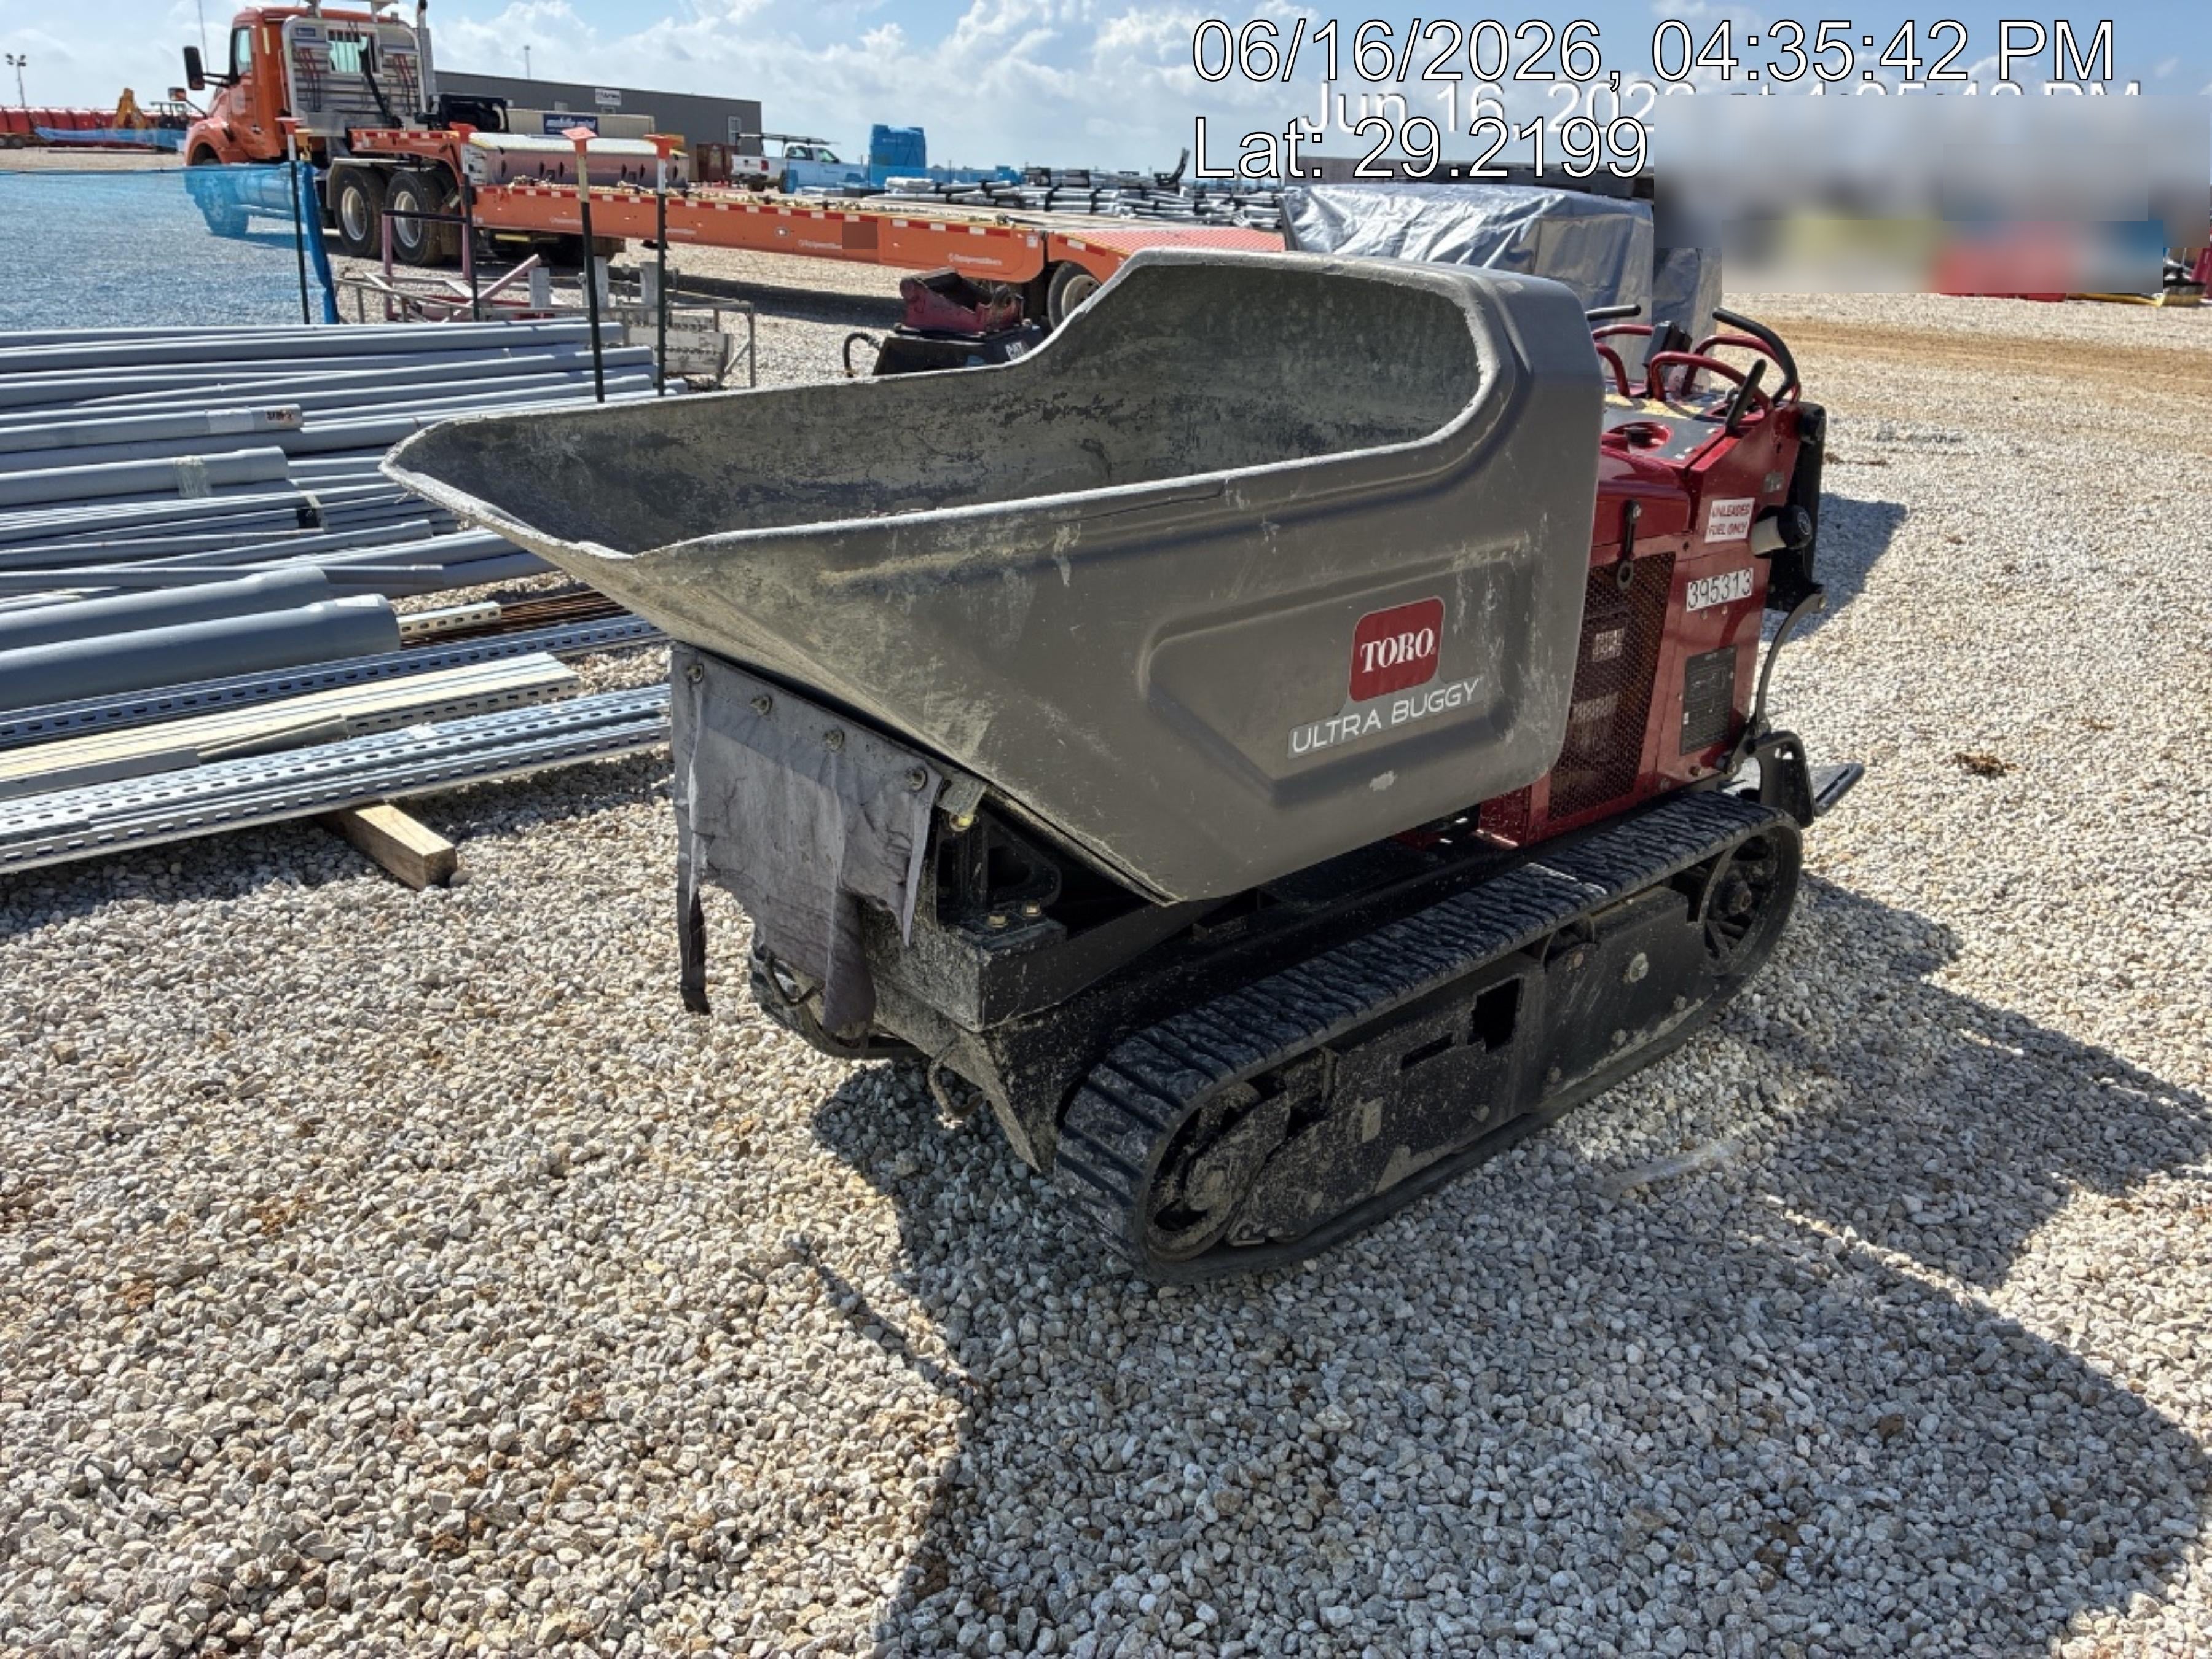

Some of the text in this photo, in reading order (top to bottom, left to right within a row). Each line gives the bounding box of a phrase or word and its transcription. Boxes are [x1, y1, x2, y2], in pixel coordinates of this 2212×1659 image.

[1688, 569, 1751, 609] 395313
[1360, 627, 1435, 673] TORO
[1293, 678, 1480, 753] ULTRA BUGGY
